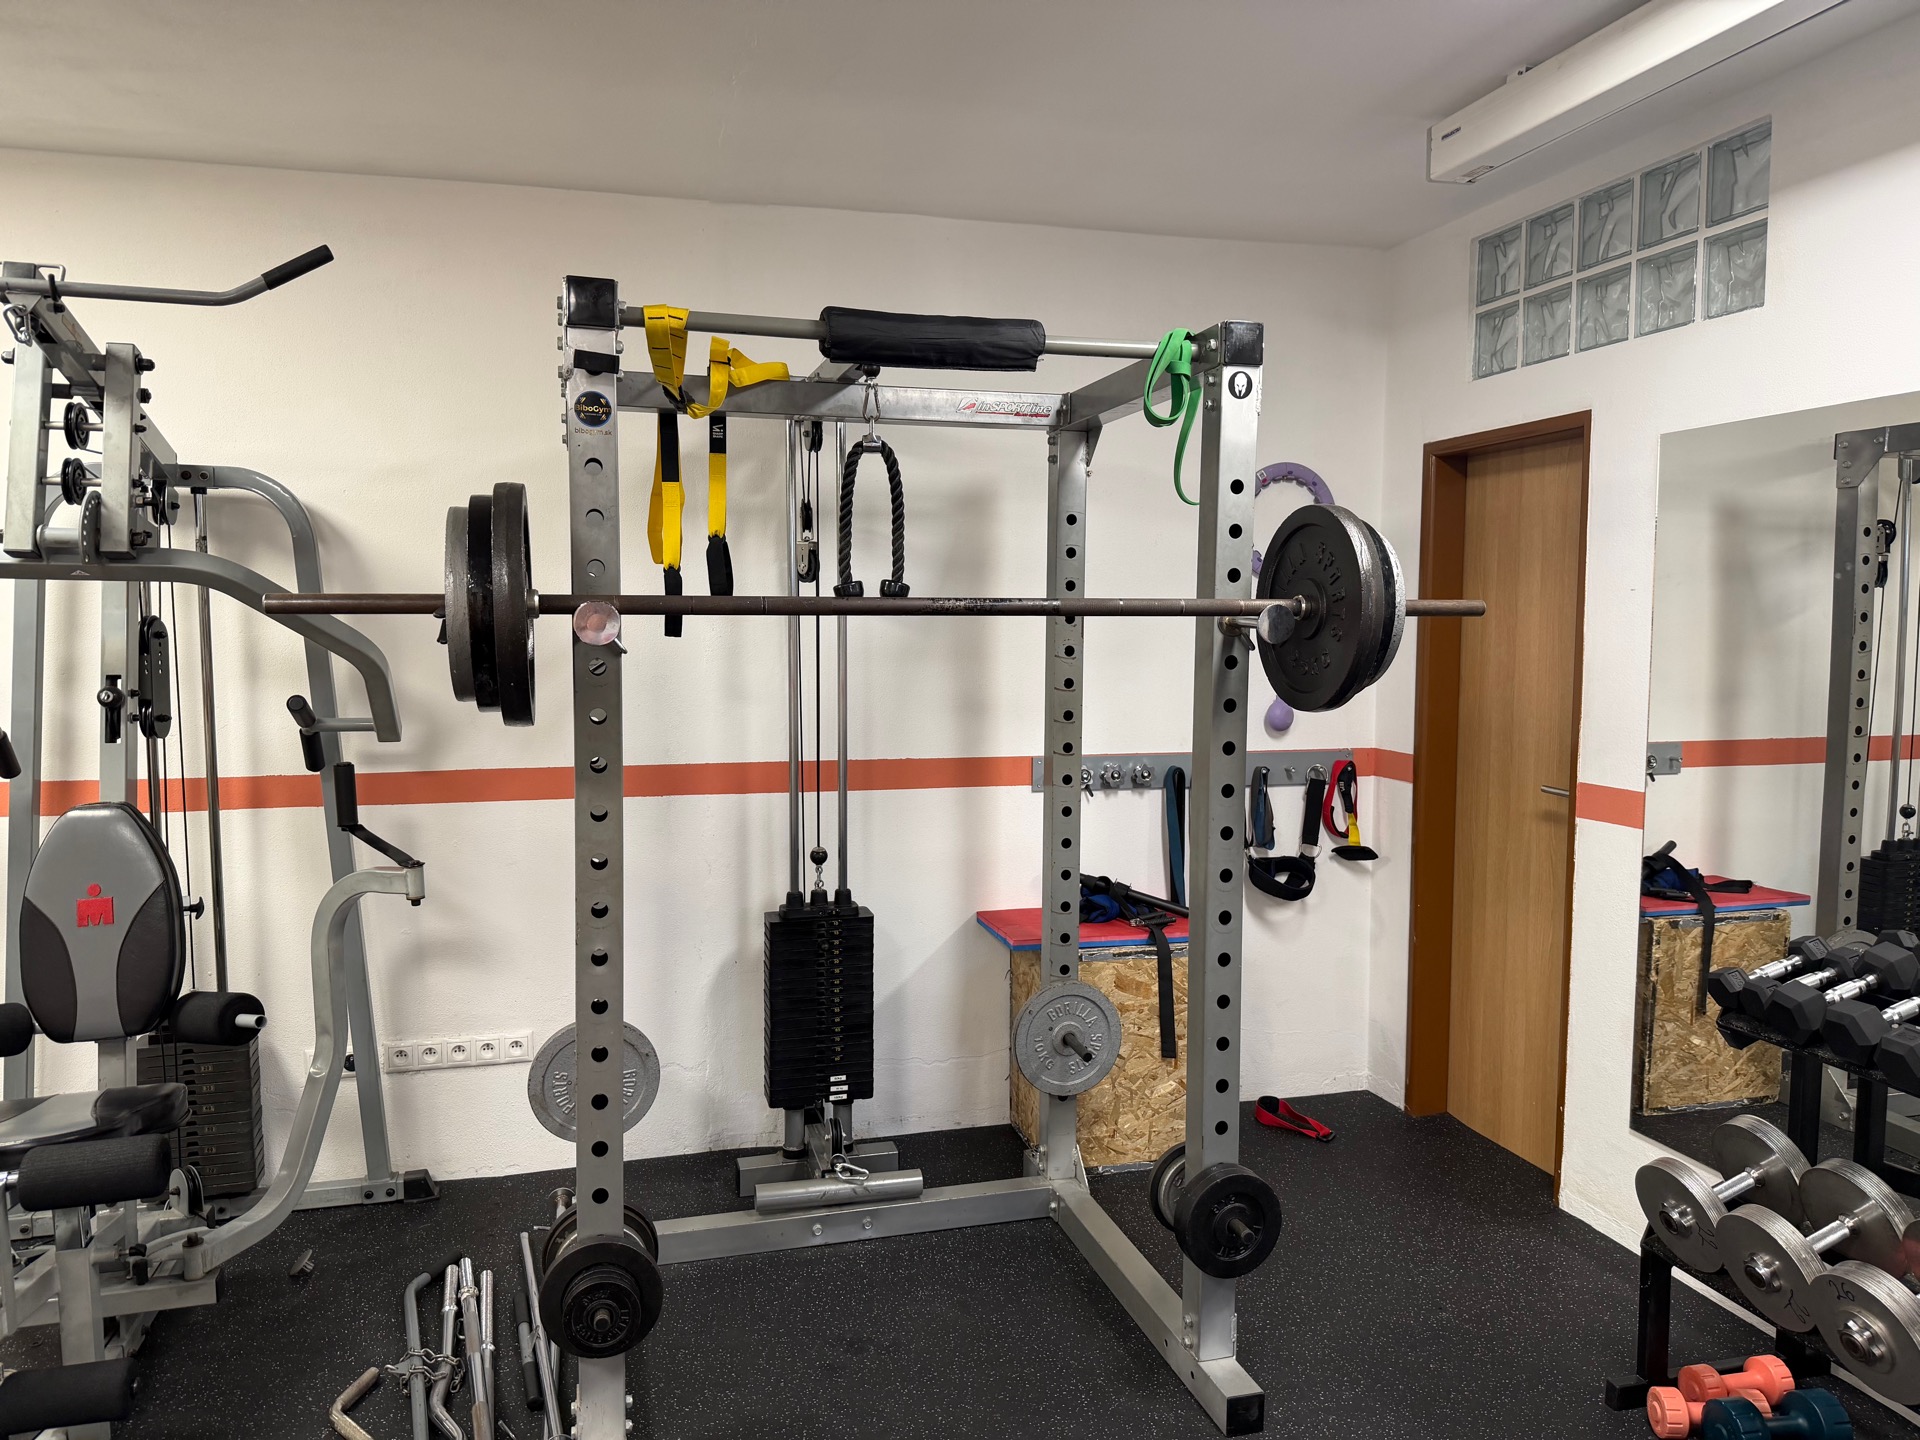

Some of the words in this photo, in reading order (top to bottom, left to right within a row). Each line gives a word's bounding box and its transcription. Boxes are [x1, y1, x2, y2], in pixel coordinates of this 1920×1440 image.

[1046, 1001, 1099, 1028] GORILLA
[1034, 1035, 1055, 1070] 10KG
[552, 1070, 576, 1119] PORTS
[1828, 1279, 1856, 1302] 26
